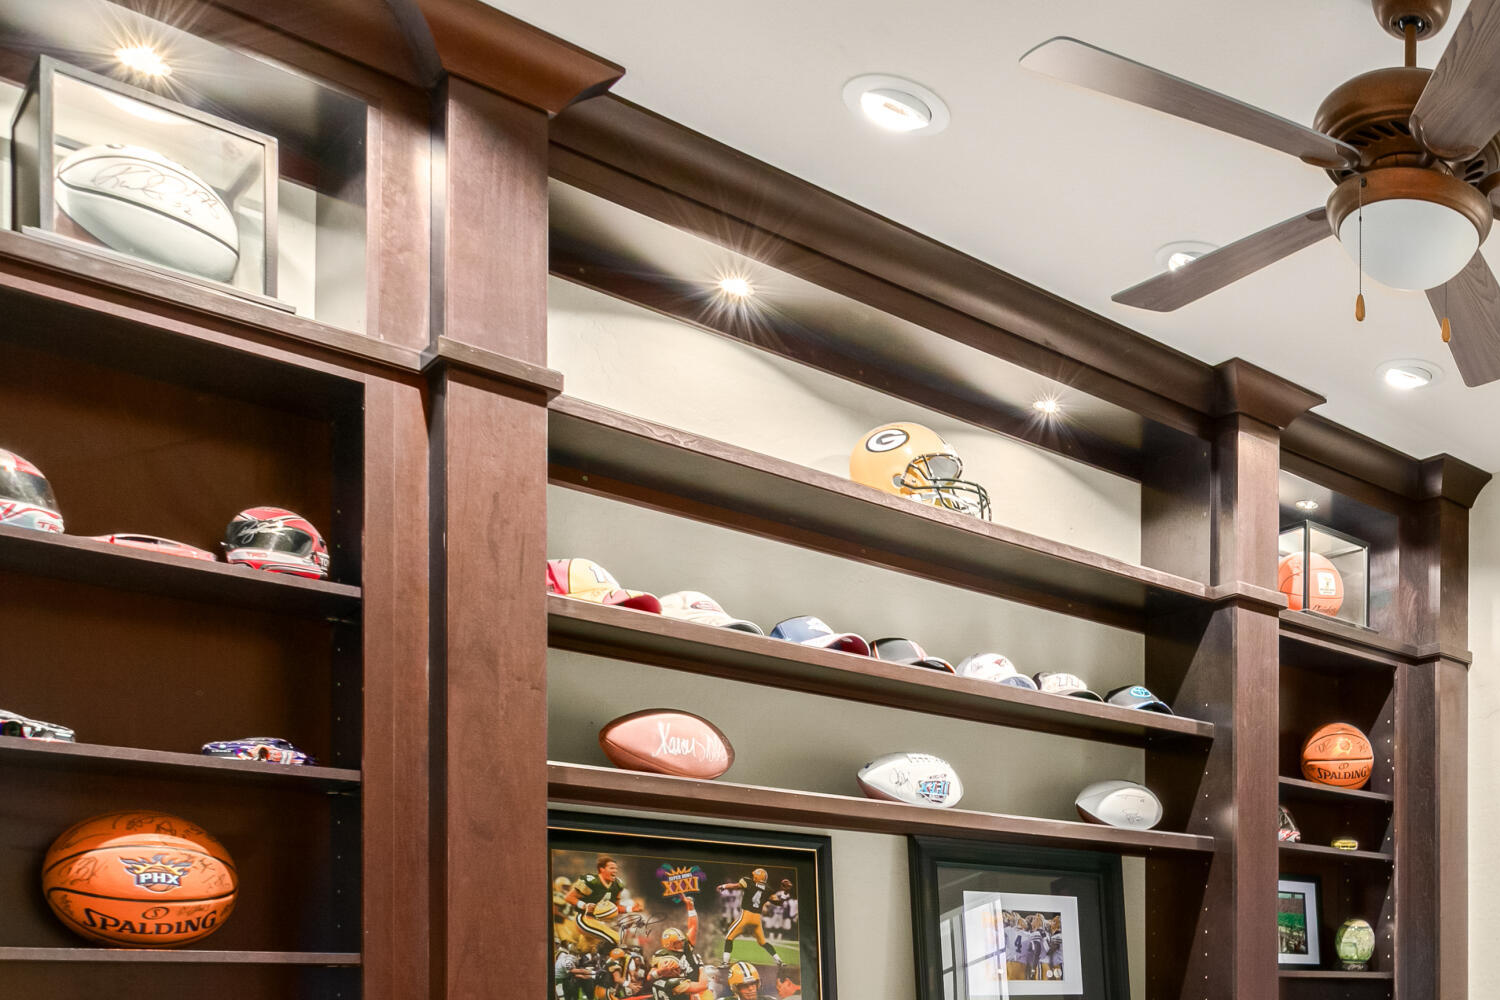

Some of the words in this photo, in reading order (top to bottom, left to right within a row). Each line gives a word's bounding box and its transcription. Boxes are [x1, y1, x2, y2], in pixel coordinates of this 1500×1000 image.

[1317, 765, 1367, 780] SPALDING
[139, 872, 180, 886] PHX
[661, 876, 700, 897] XXXI
[752, 891, 764, 909] 4
[82, 907, 217, 936] SPALDING
